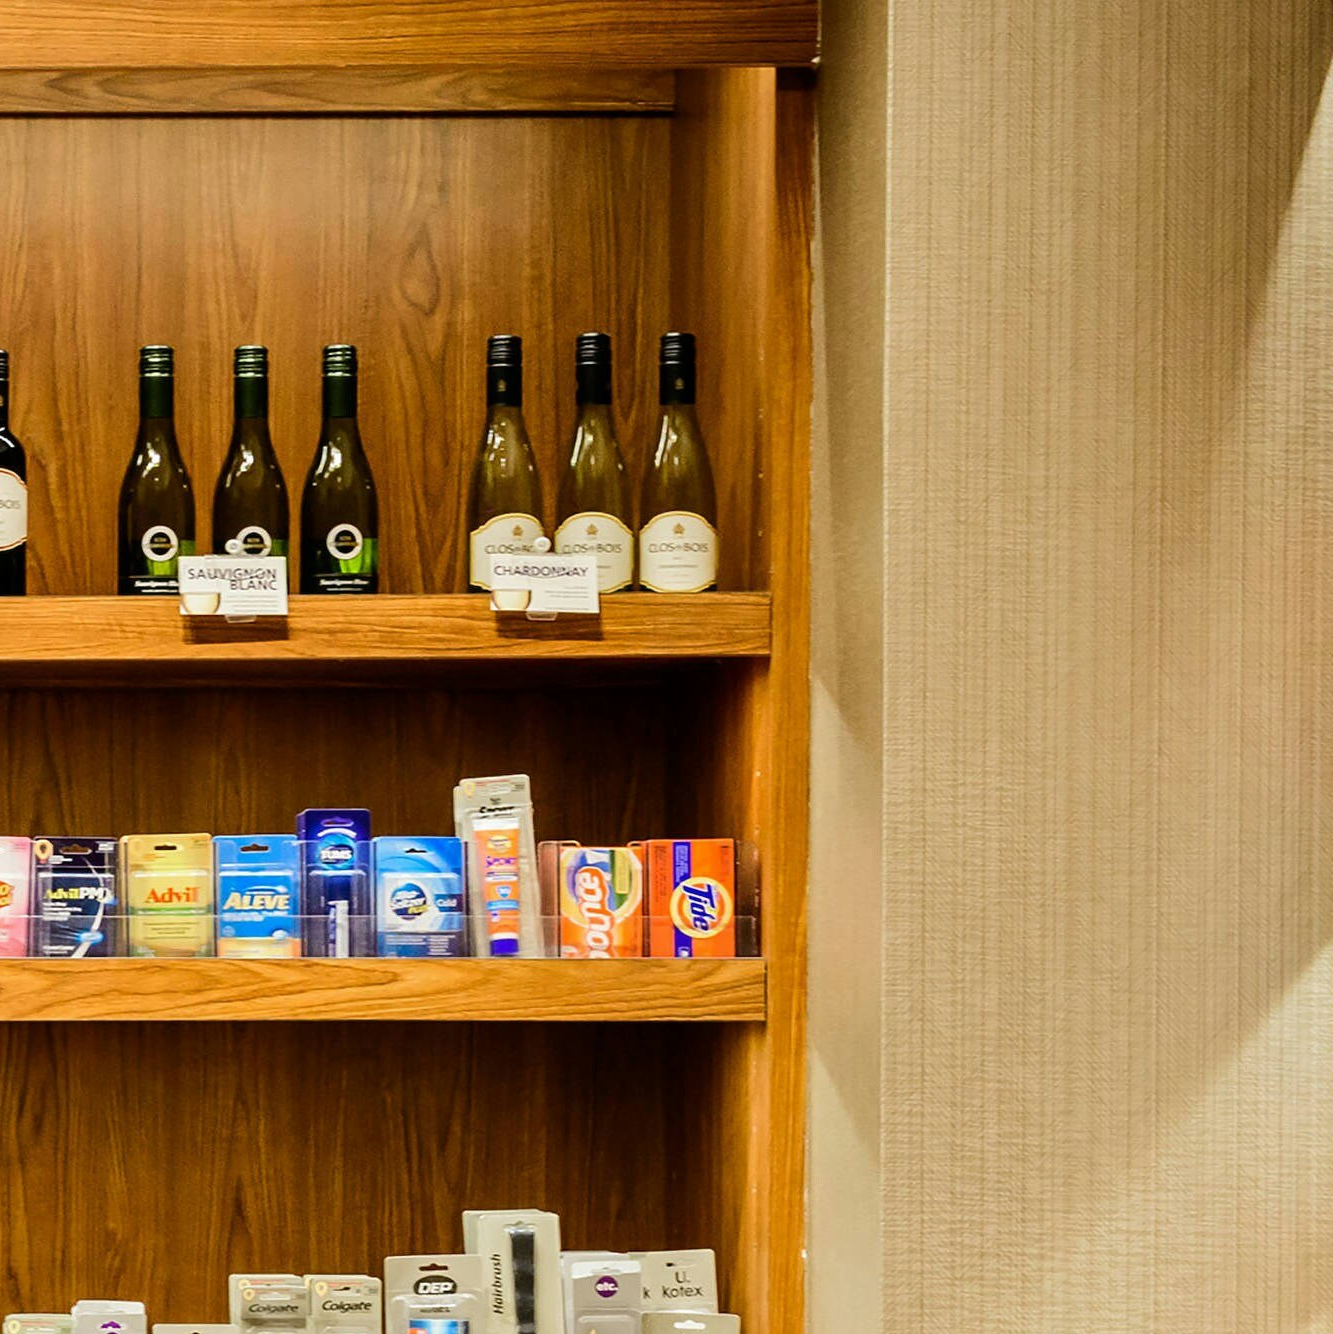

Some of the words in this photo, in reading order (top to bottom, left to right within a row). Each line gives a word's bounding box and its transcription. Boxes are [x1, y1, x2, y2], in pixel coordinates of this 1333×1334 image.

[649, 542, 676, 553] CLOS
[684, 542, 709, 553] BOIS
[188, 568, 277, 580] SAUVIGNON
[494, 565, 589, 577] CHARDONNAY
[229, 580, 278, 591] BLANC
[146, 886, 199, 903] Advil
[223, 892, 290, 910] ALEVE
[683, 882, 717, 932] Tide
[418, 1282, 454, 1293] DEP
[490, 1253, 504, 1315] Hairbrush
[662, 1285, 704, 1298] kotex
[248, 1303, 299, 1314] Colgate
[322, 1300, 373, 1314] Colgate
